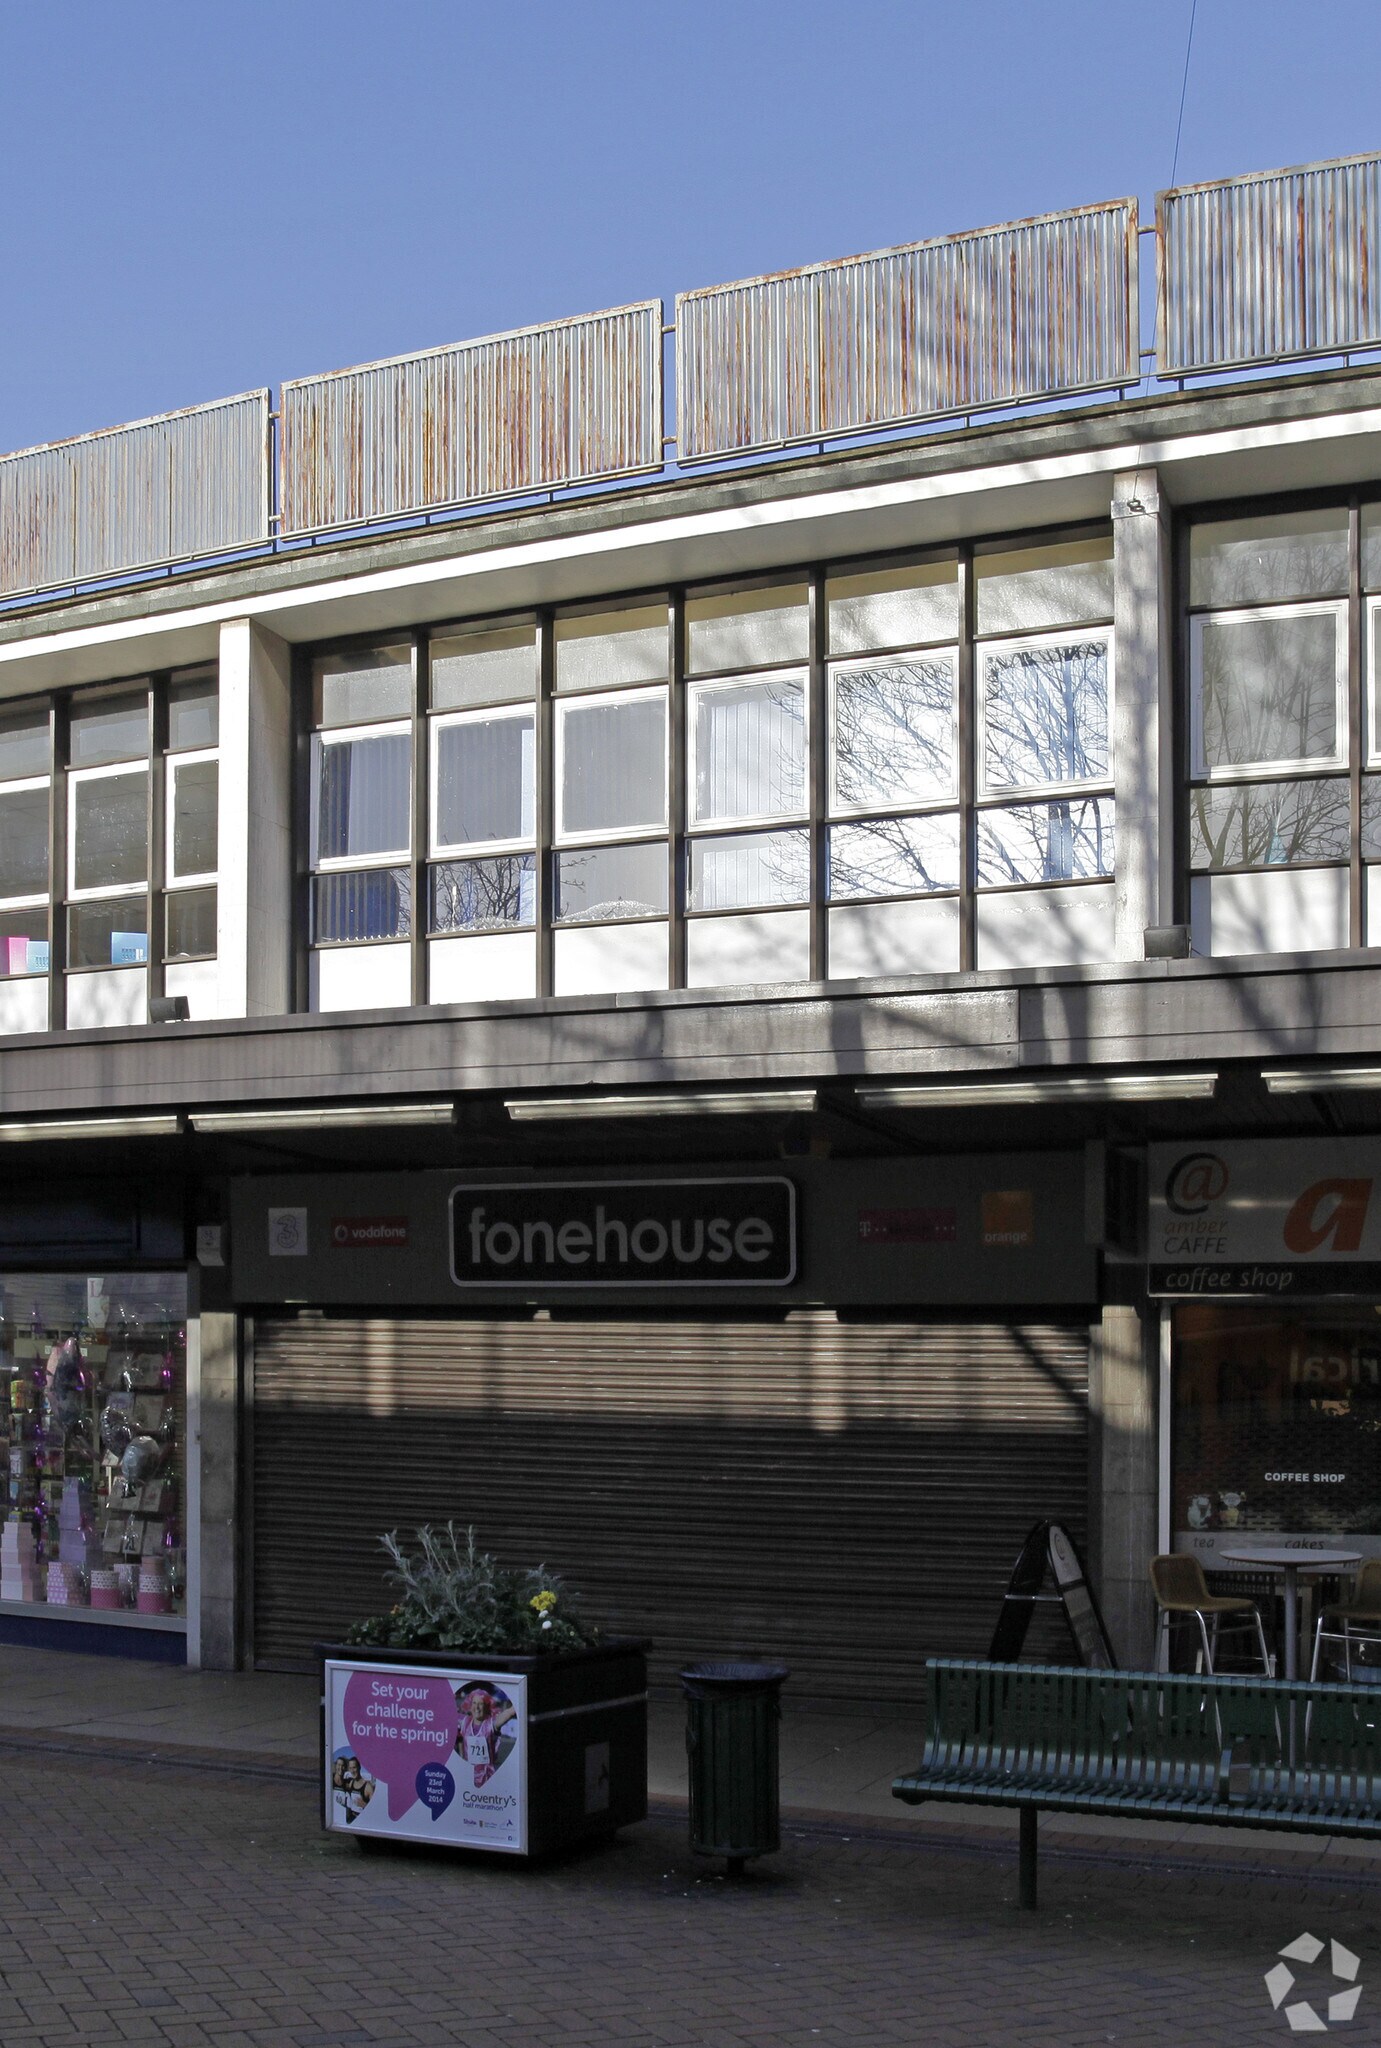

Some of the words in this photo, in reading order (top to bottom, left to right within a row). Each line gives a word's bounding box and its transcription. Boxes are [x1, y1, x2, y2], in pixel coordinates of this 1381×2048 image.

[276, 1214, 299, 1249] 3
[1164, 1216, 1229, 1234] amber
[351, 1225, 407, 1239] vodafone
[468, 1205, 774, 1265] fonehouse
[984, 1231, 1029, 1244] orange
[1164, 1236, 1228, 1254] CAFFE
[1165, 1266, 1232, 1291] coffee
[1239, 1267, 1293, 1290] shop
[1264, 1472, 1310, 1482] COFFEE
[1312, 1473, 1346, 1483] SHOP
[1193, 1536, 1215, 1548] tea
[1284, 1537, 1326, 1550] cakes
[371, 1681, 393, 1697] Set
[396, 1686, 429, 1701] your
[366, 1702, 434, 1724] challenge
[352, 1721, 372, 1736] for
[375, 1723, 398, 1739] the
[401, 1727, 449, 1746] spring!
[470, 1744, 485, 1756] 721
[424, 1770, 446, 1780] Sunday
[428, 1778, 443, 1787] 23rd
[426, 1787, 445, 1795] March
[428, 1795, 443, 1803] 2014
[462, 1791, 517, 1808] Coventry's
[462, 1802, 473, 1810] half
[474, 1803, 504, 1812] marathon
